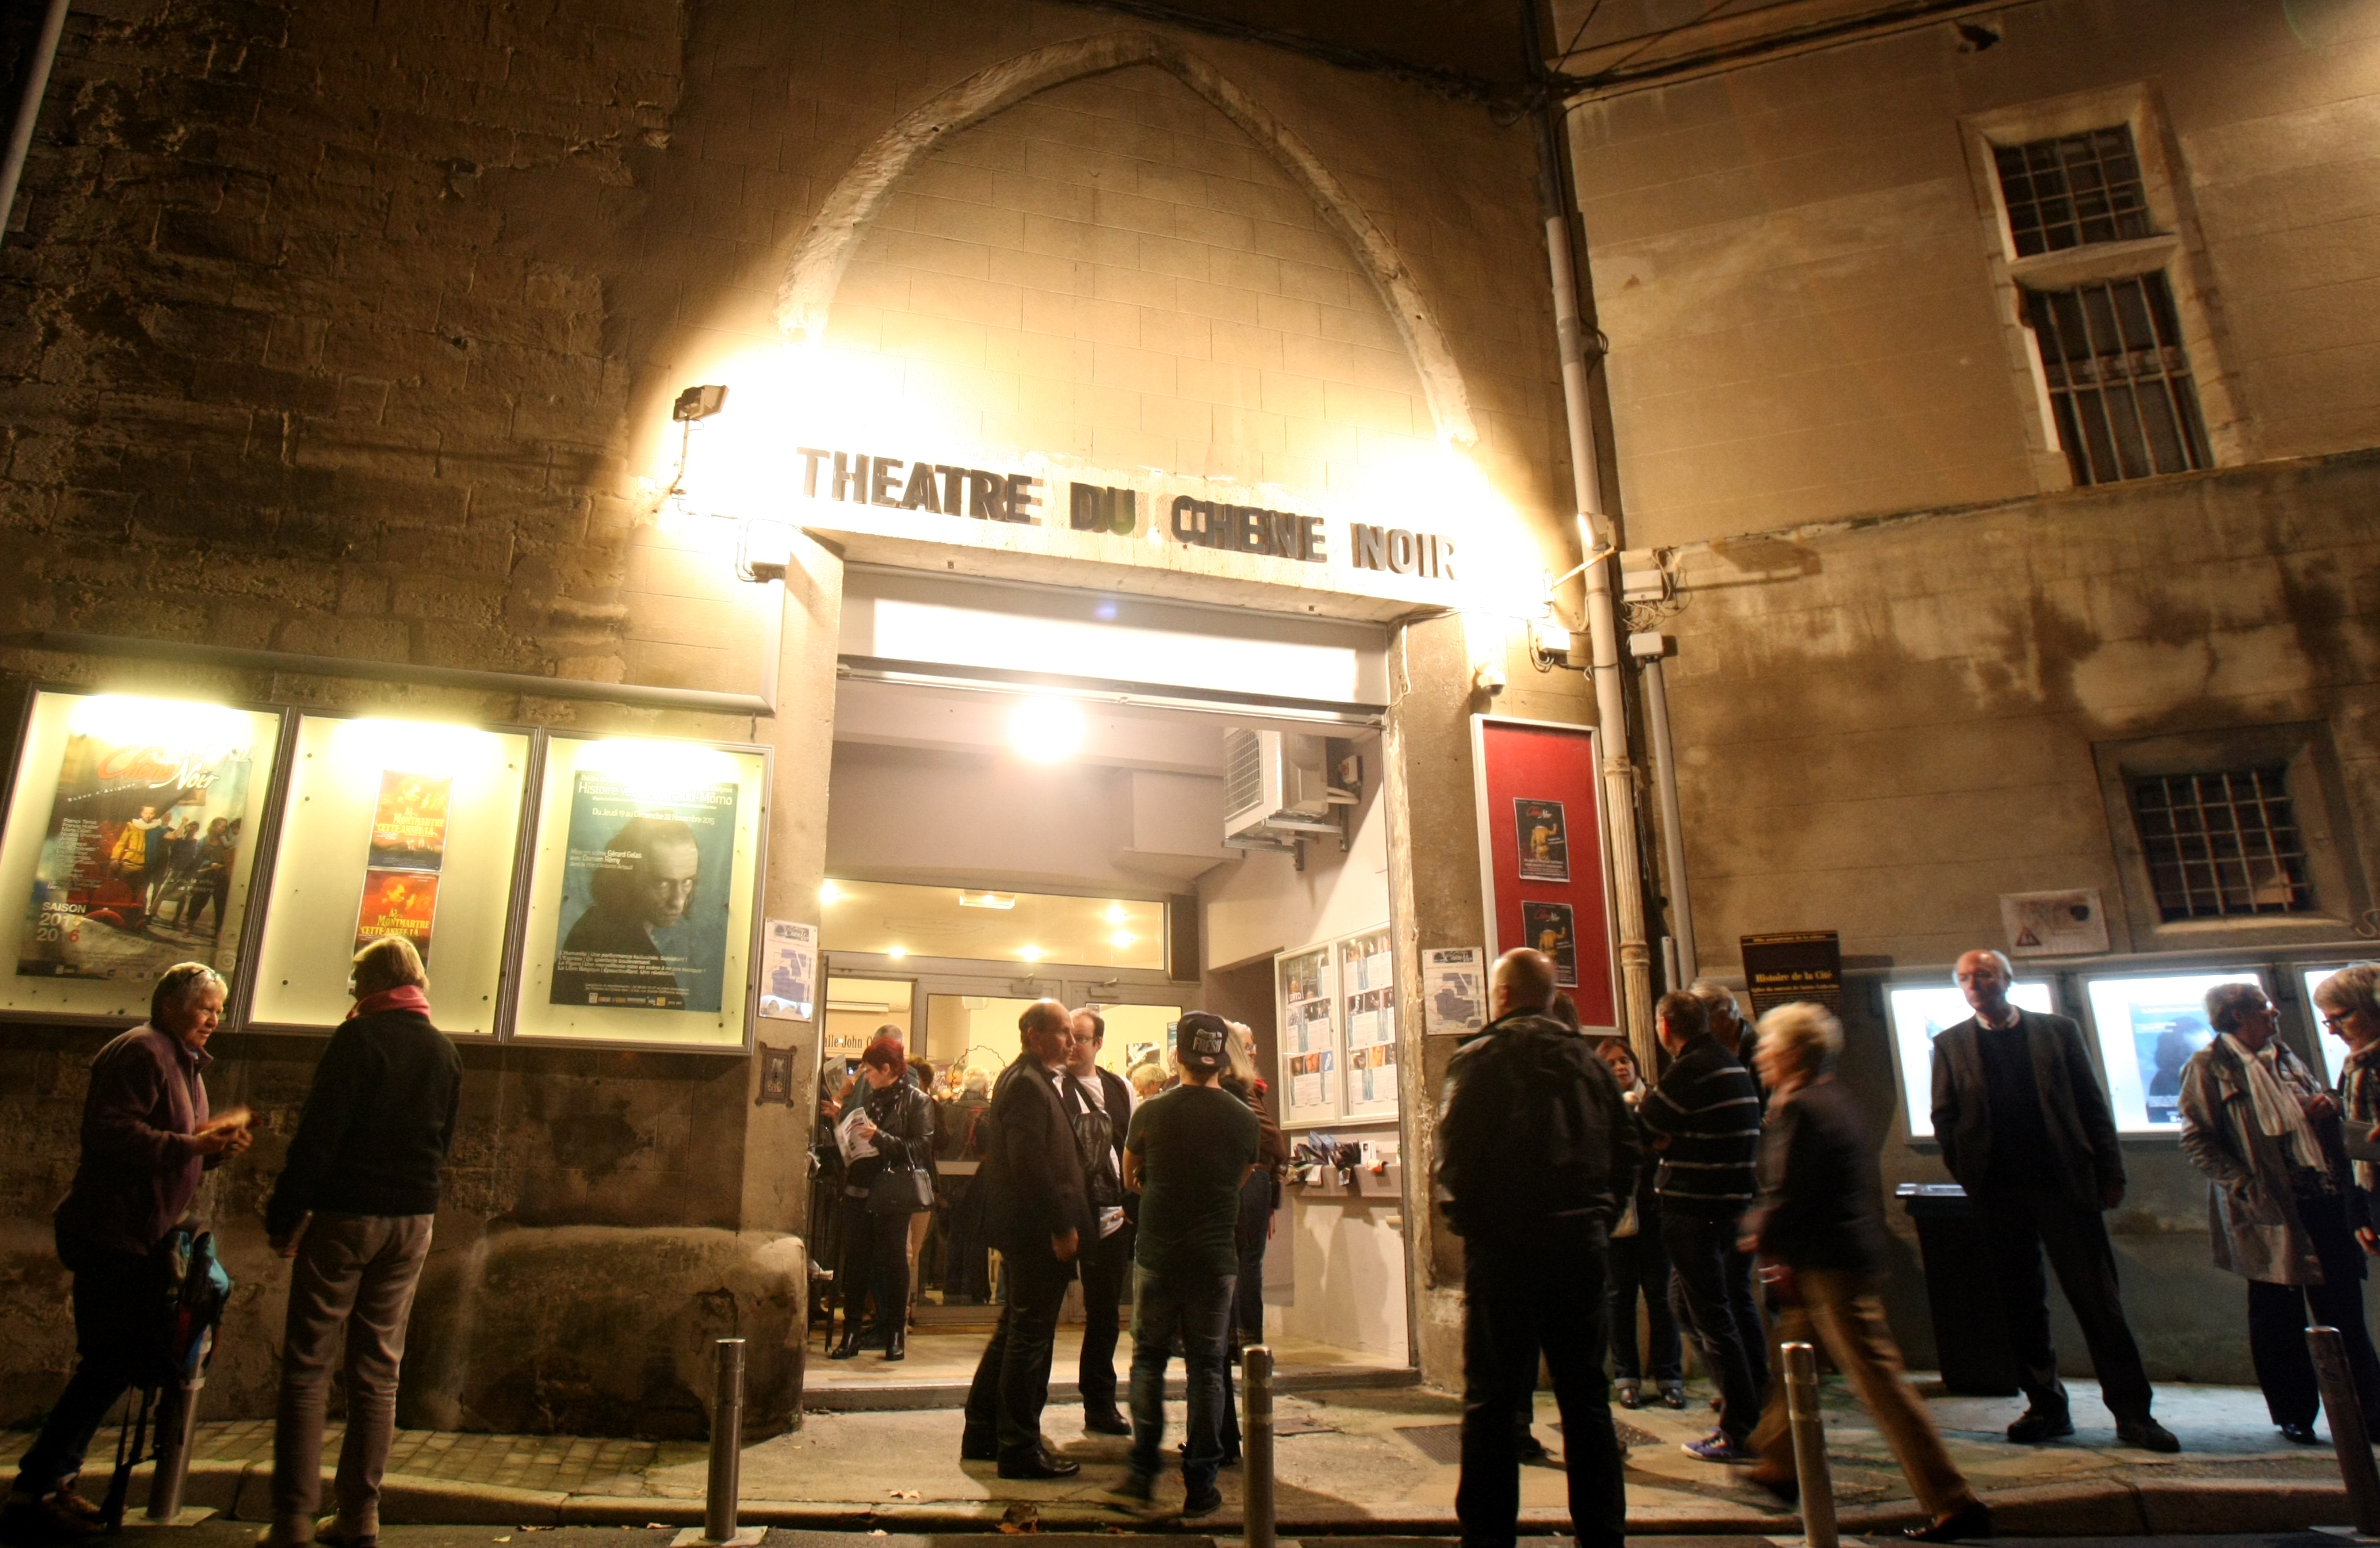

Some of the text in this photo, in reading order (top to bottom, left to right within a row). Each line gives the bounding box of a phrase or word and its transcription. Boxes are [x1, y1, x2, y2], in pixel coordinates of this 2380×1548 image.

[797, 447, 1458, 580] THEATRE DU CHENE NOIR
[148, 758, 219, 790] Noir
[578, 781, 620, 796] Histoire
[592, 807, 601, 815] Du
[602, 809, 618, 817] Jeudi
[702, 816, 715, 825] 2015
[607, 849, 626, 858] Gérard
[42, 901, 87, 913] SAISON
[377, 915, 431, 929] MONTMARTRE
[36, 927, 81, 943] 2016
[1756, 970, 1833, 983] Histoire de la Cité
[842, 1035, 863, 1049] John
[1193, 1036, 1223, 1054] FRESH
